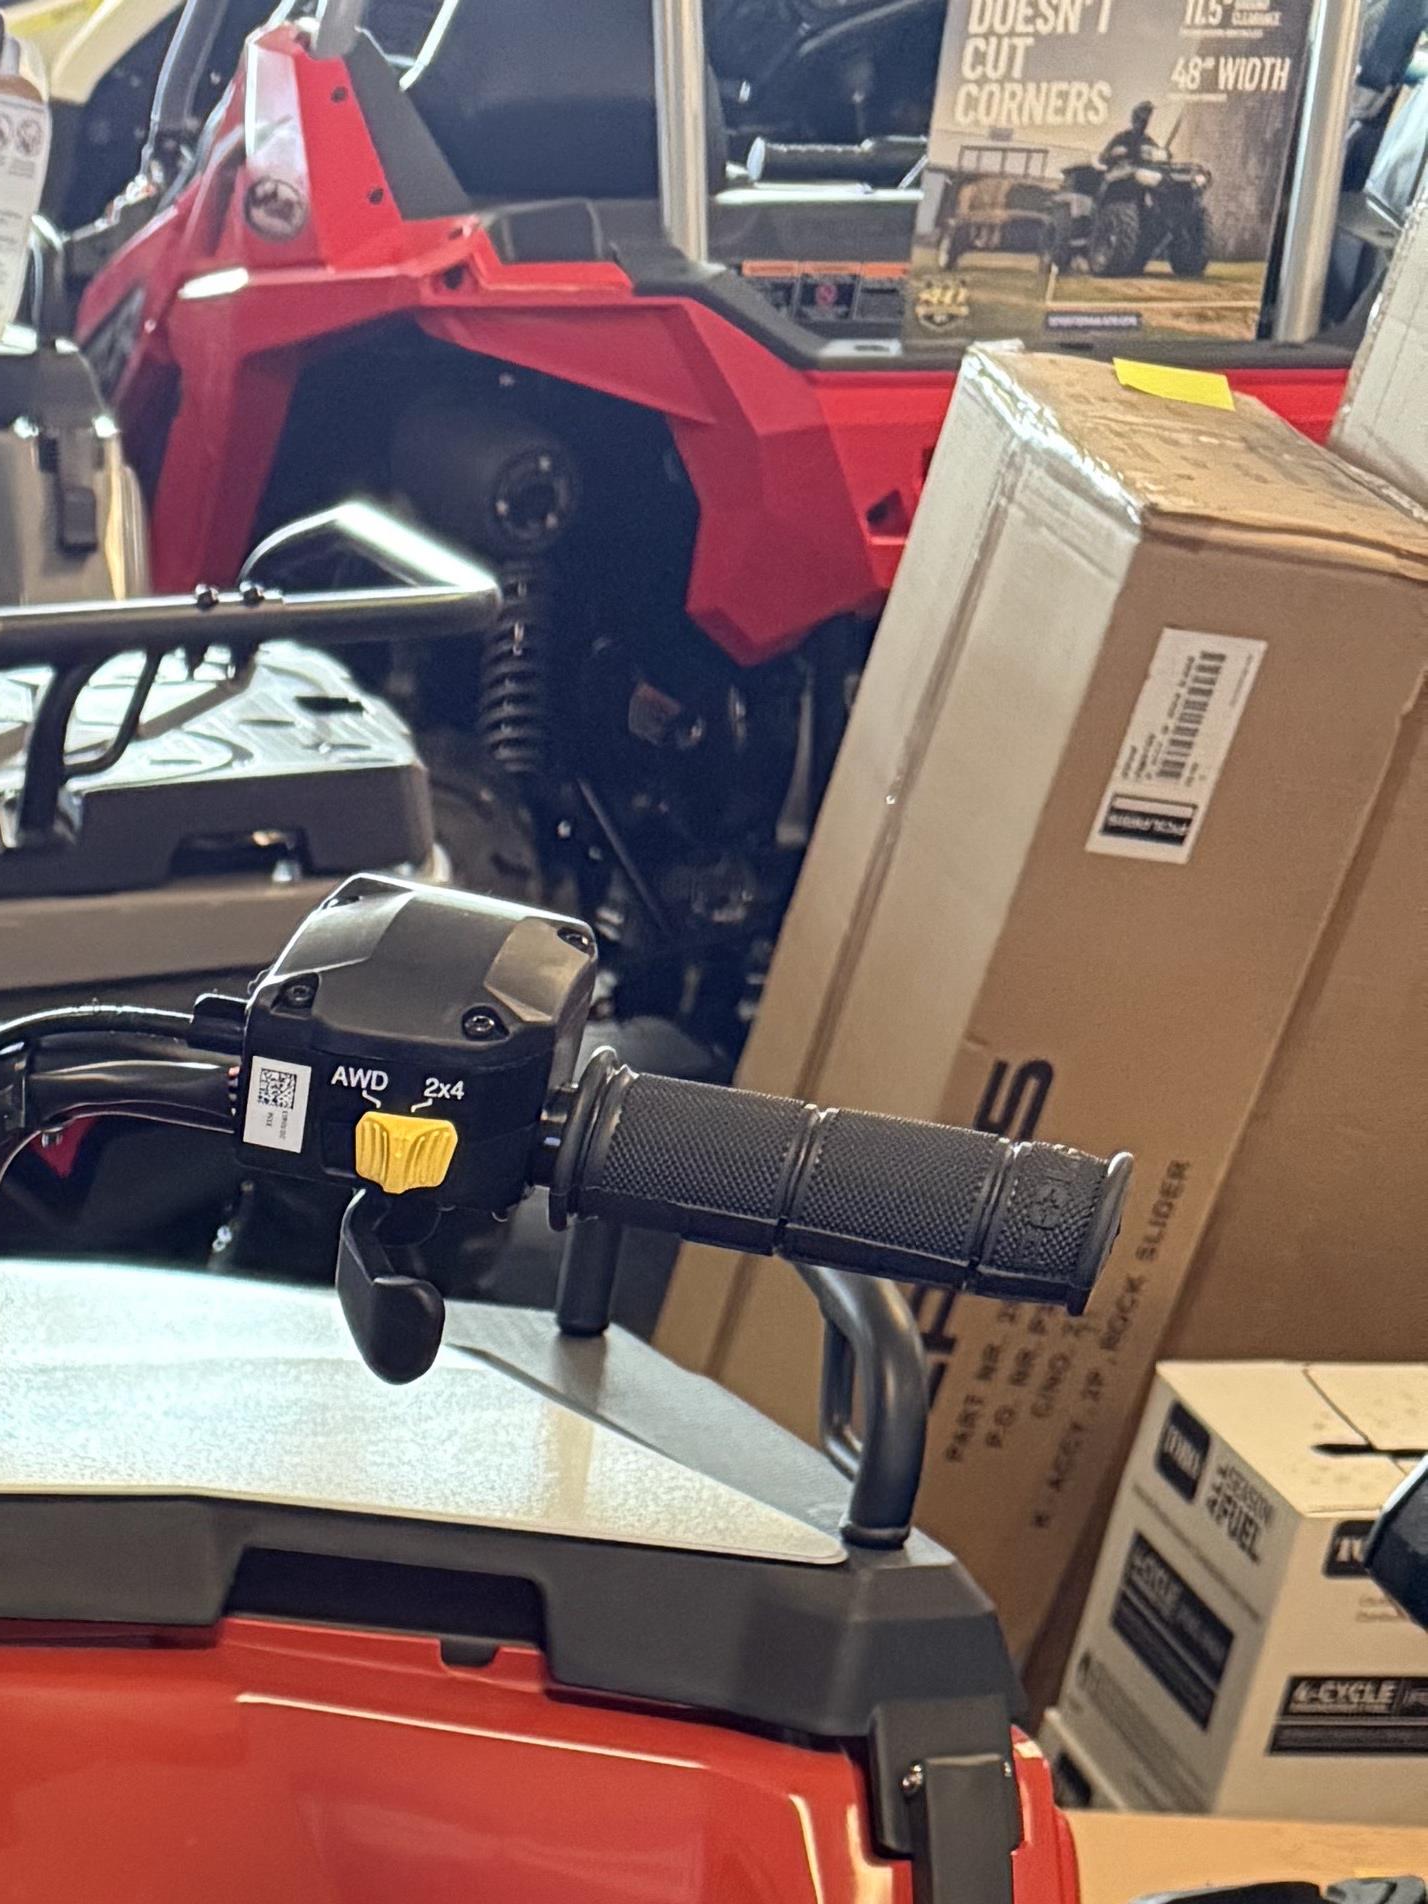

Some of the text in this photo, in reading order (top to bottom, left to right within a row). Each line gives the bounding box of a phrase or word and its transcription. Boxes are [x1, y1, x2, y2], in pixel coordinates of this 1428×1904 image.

[961, 36, 1035, 81] CUT
[1218, 57, 1291, 92] WIDTH
[955, 81, 1112, 126] CORNERS
[331, 1065, 389, 1091] AWD
[424, 1077, 464, 1100] 2x4
[1134, 1158, 1193, 1264] SLIDER
